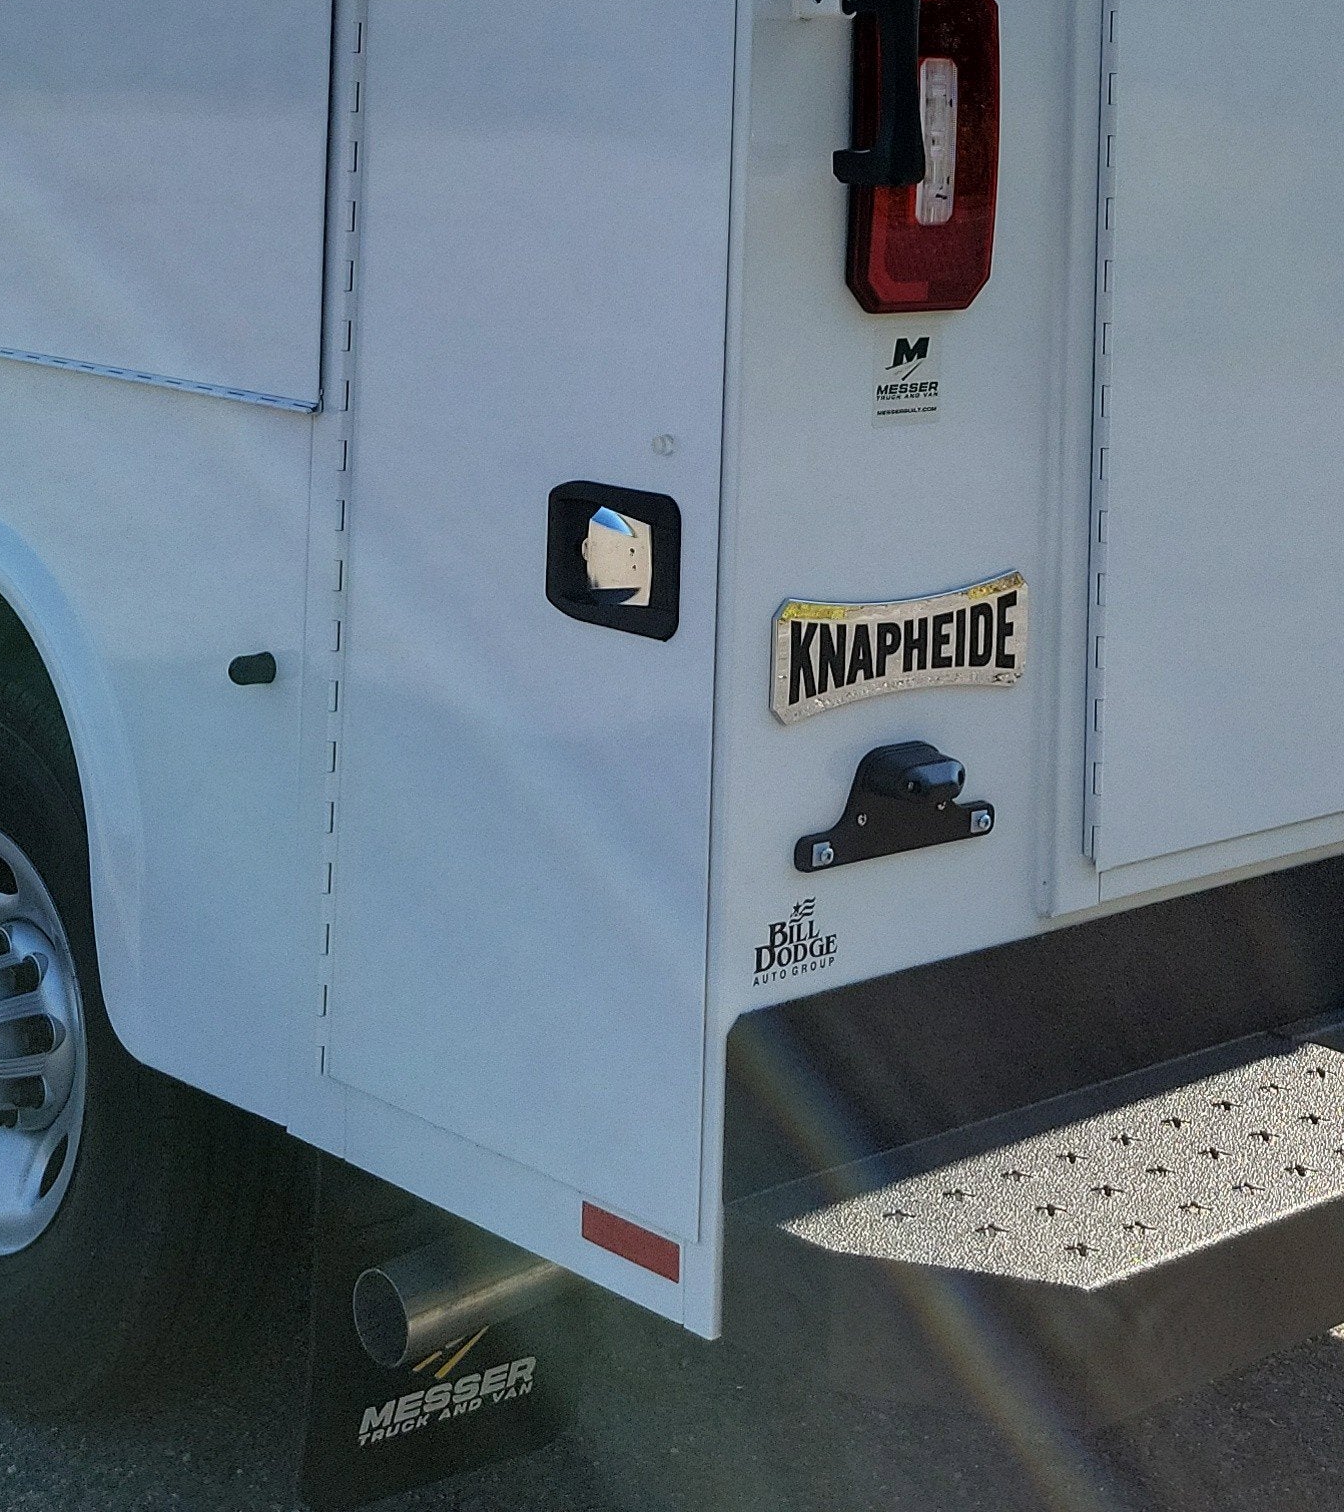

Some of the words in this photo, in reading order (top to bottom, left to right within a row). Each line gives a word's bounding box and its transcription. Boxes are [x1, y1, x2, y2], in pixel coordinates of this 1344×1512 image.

[876, 381, 939, 395] MESSER
[787, 589, 1018, 706] KNAPHEIDE
[753, 934, 838, 974] DODGE
[768, 920, 820, 950] BILL
[753, 969, 787, 987] AUTO
[791, 956, 835, 976] GROUP
[357, 1356, 537, 1435] MESSER
[357, 1415, 429, 1447] TRUCK
[438, 1399, 482, 1422] AND
[492, 1381, 534, 1404] VAN
